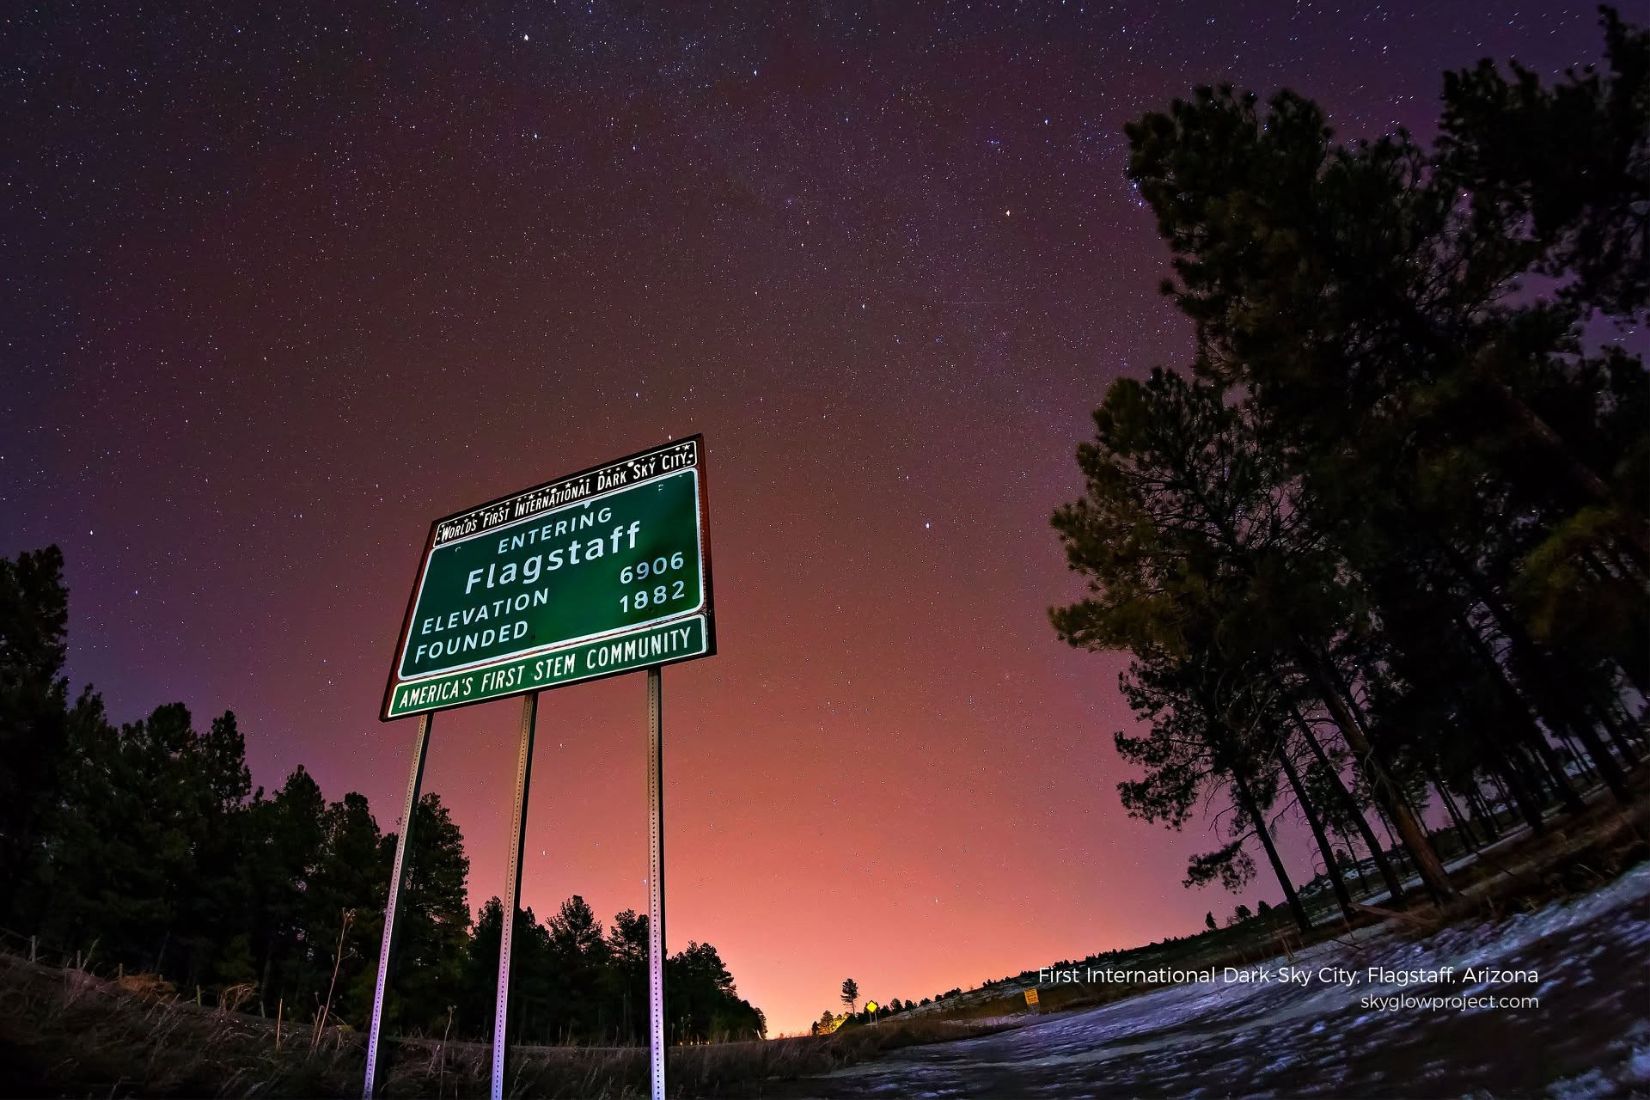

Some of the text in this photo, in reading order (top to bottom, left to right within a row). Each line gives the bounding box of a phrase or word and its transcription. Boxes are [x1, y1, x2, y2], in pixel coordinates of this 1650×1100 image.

[482, 508, 510, 528] FIRST
[514, 482, 591, 517] INTERNATIONAL
[597, 470, 627, 491] DARK
[633, 461, 656, 480] SKY
[662, 452, 688, 470] CITY
[465, 521, 641, 595] Flagstaff
[497, 507, 612, 555] ENTERING
[415, 581, 685, 664] FOUNDED 1882
[421, 551, 685, 635] ELEVATION 6906
[399, 626, 692, 709] AMERICA'S FIRST STEM COMMUNITY
